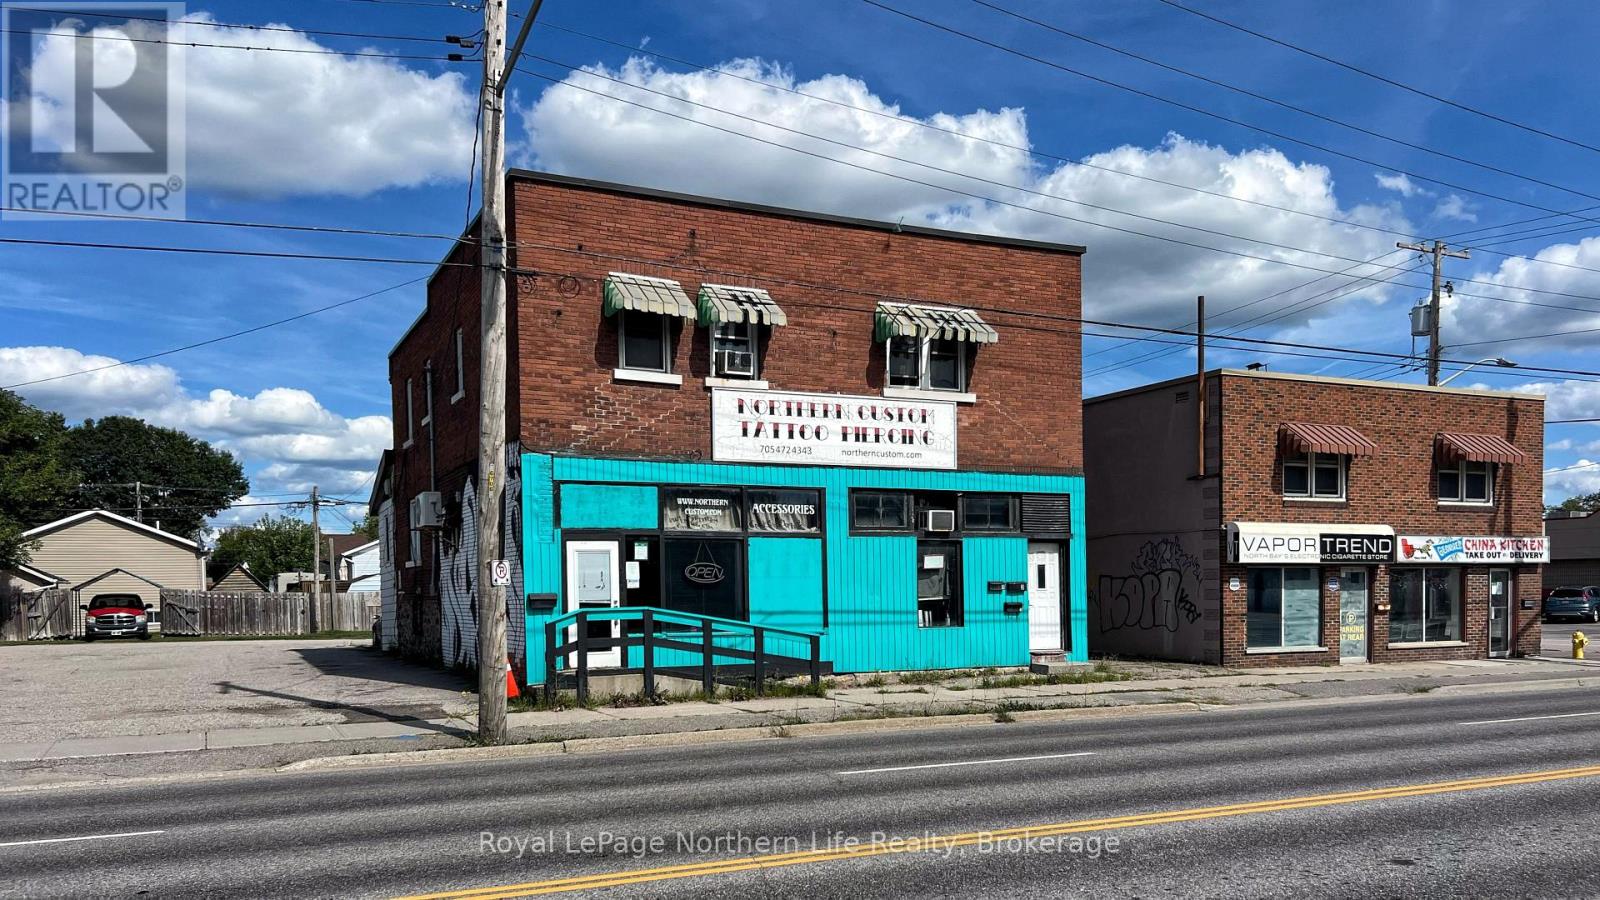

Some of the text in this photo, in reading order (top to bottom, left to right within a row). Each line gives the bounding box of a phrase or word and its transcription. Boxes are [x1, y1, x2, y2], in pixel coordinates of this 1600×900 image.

[737, 398, 935, 424] NORTHERN CUSTOM
[737, 420, 935, 445] TATTOO PIERCING
[760, 445, 922, 459] 7054724343 northerncustom.com
[752, 503, 815, 515] ACCESSORIES
[1242, 537, 1392, 554] VAPOR TREND
[1464, 538, 1498, 551] CHINA
[1500, 539, 1544, 551] KITCHEN
[1465, 551, 1485, 559] TAKE
[1486, 551, 1502, 559] OUT
[1509, 551, 1544, 559] DELIVERY
[689, 566, 724, 578] OPEN
